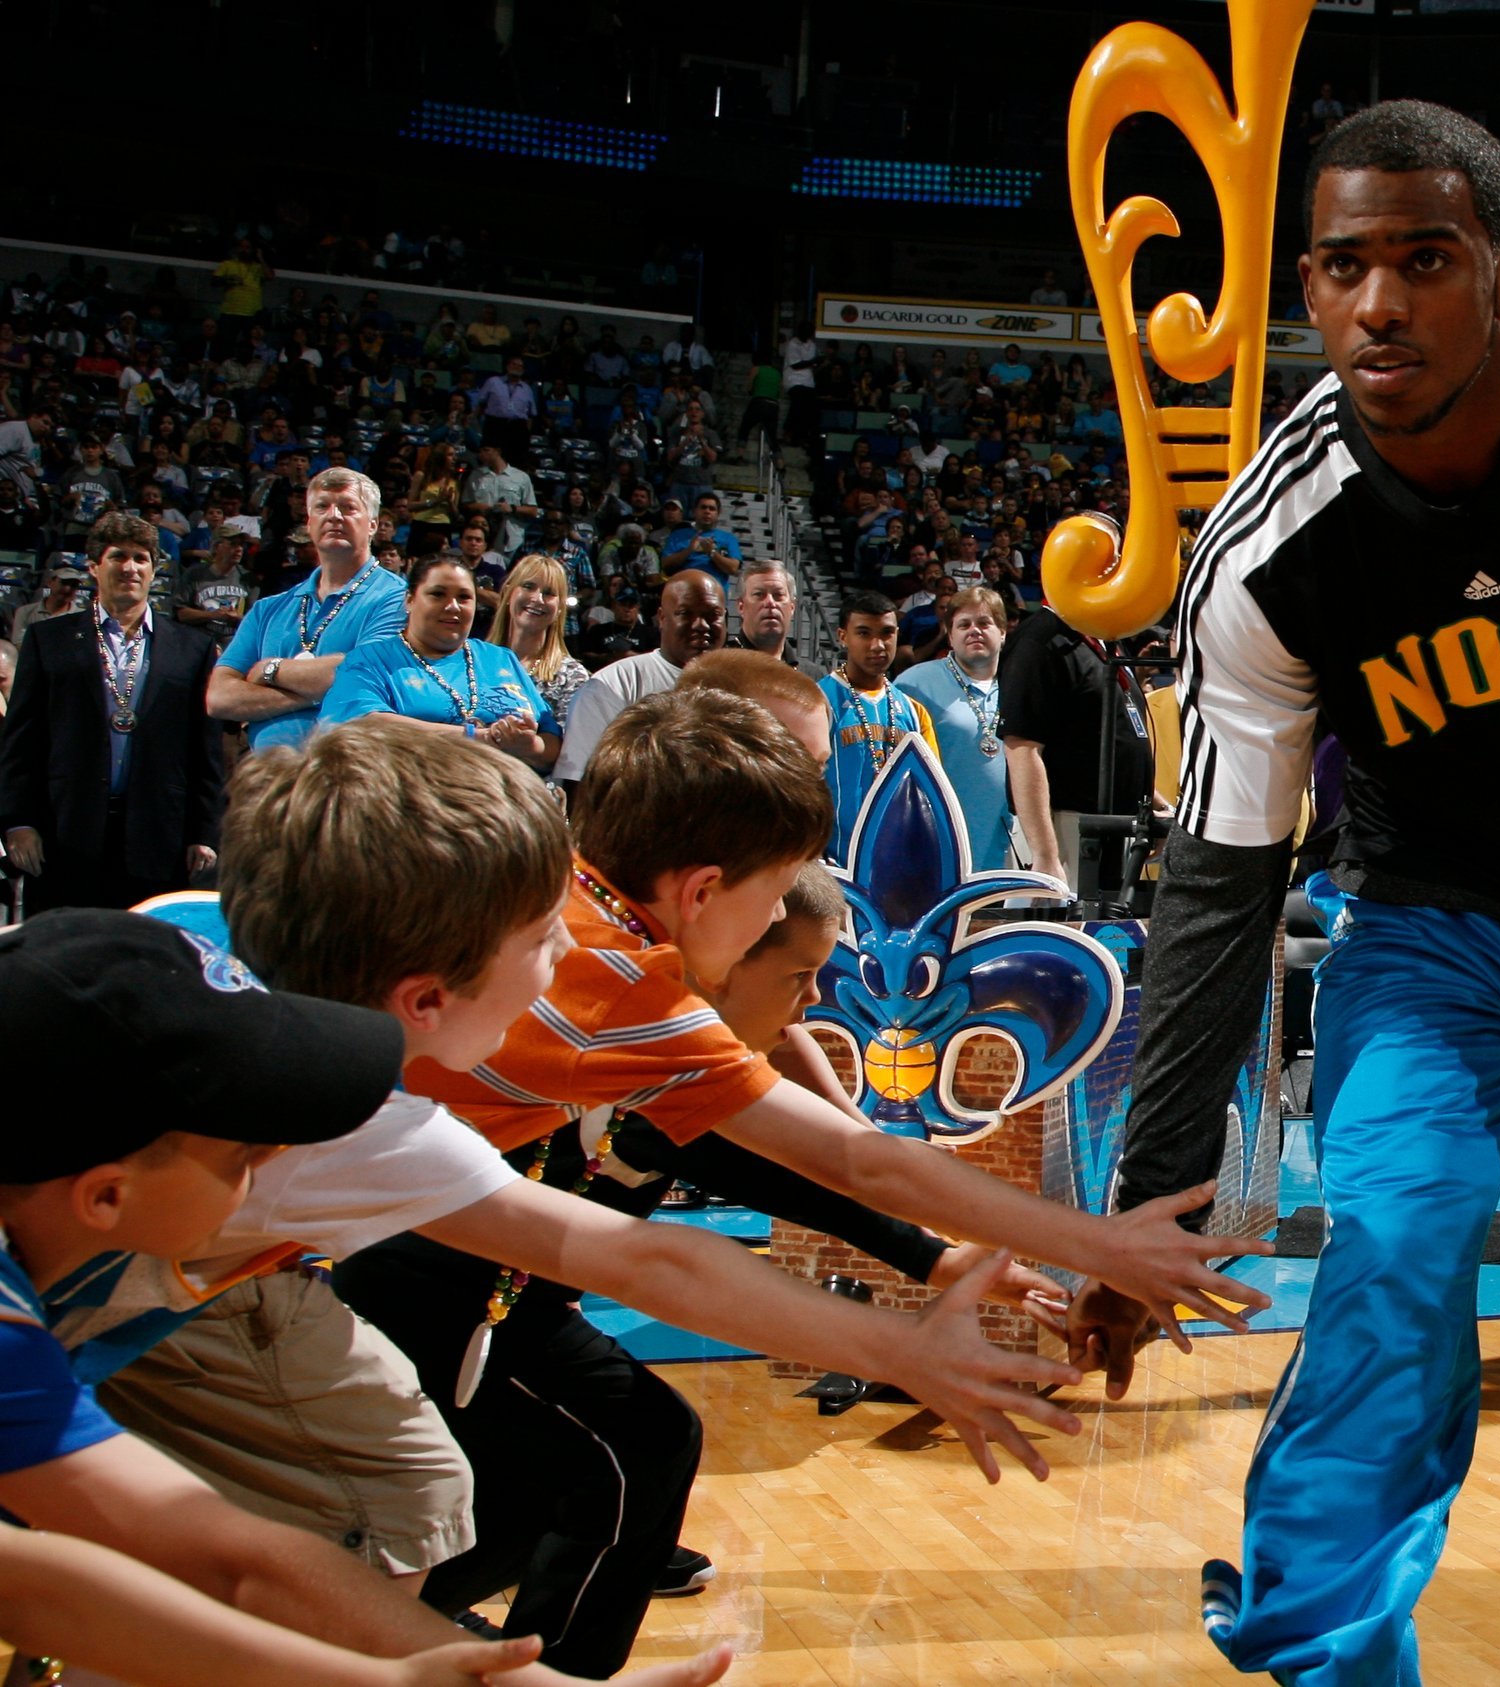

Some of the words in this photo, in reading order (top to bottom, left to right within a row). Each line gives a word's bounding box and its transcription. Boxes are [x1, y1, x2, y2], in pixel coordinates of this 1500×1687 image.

[862, 309, 923, 323] BACARDI
[926, 313, 968, 325] GOLD
[991, 315, 1042, 332] ZONE
